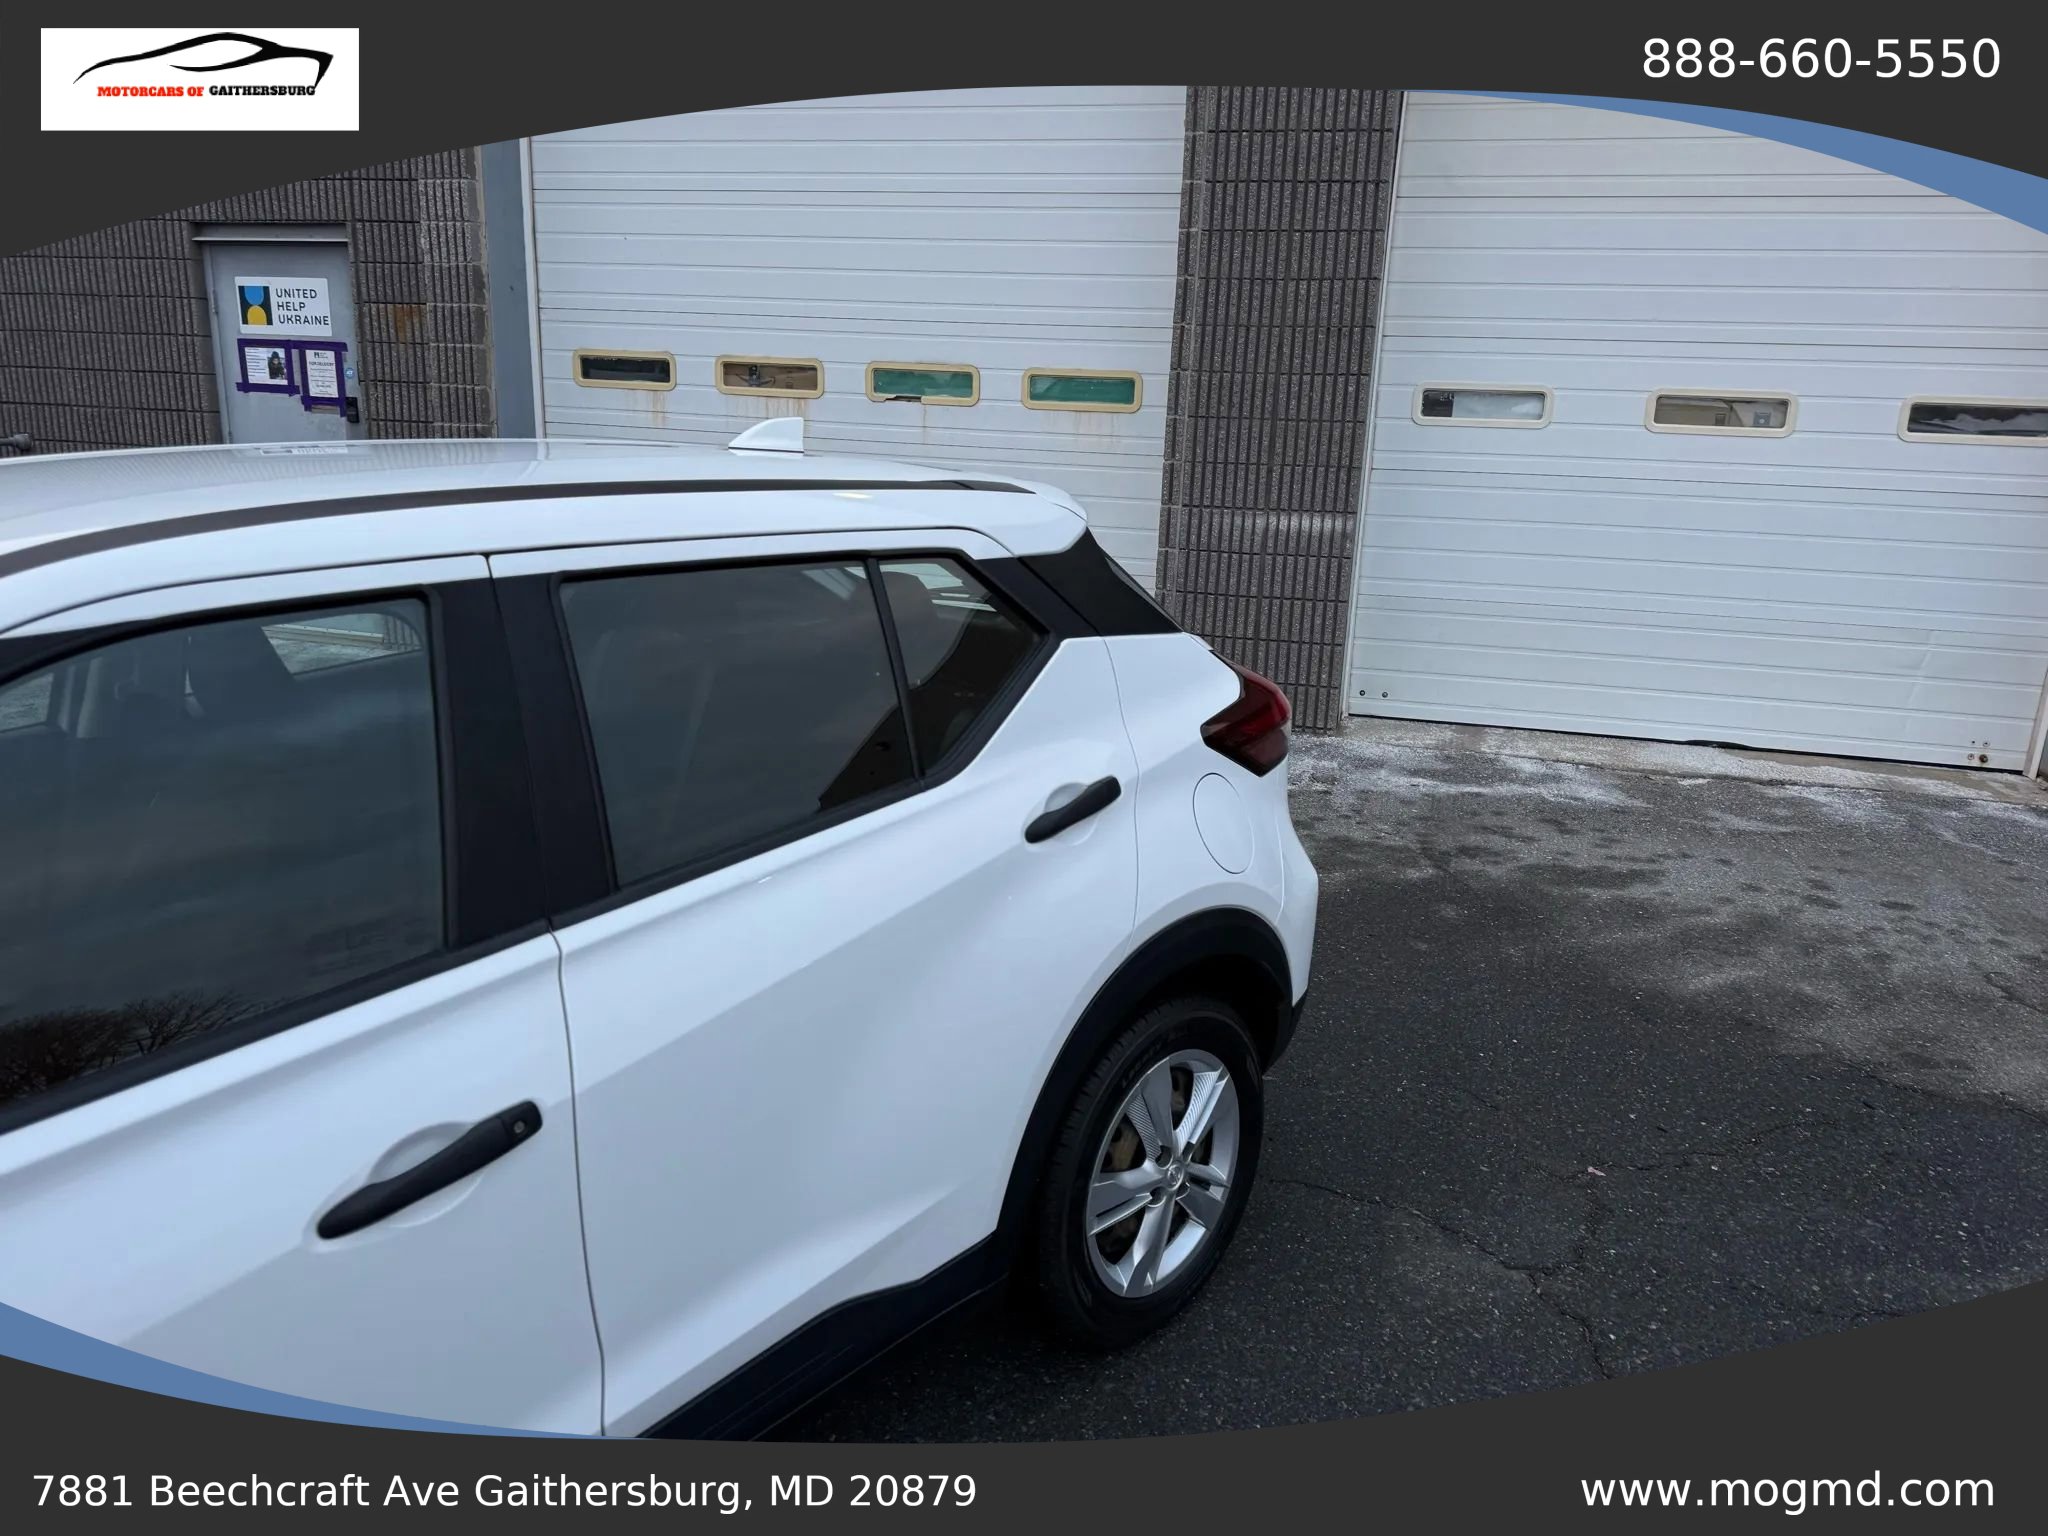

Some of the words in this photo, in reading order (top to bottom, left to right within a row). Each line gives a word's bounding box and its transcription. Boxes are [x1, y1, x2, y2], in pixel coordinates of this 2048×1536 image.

[276, 288, 317, 298] UNITED
[277, 302, 306, 311] HELP
[278, 314, 329, 326] UKRAINE
